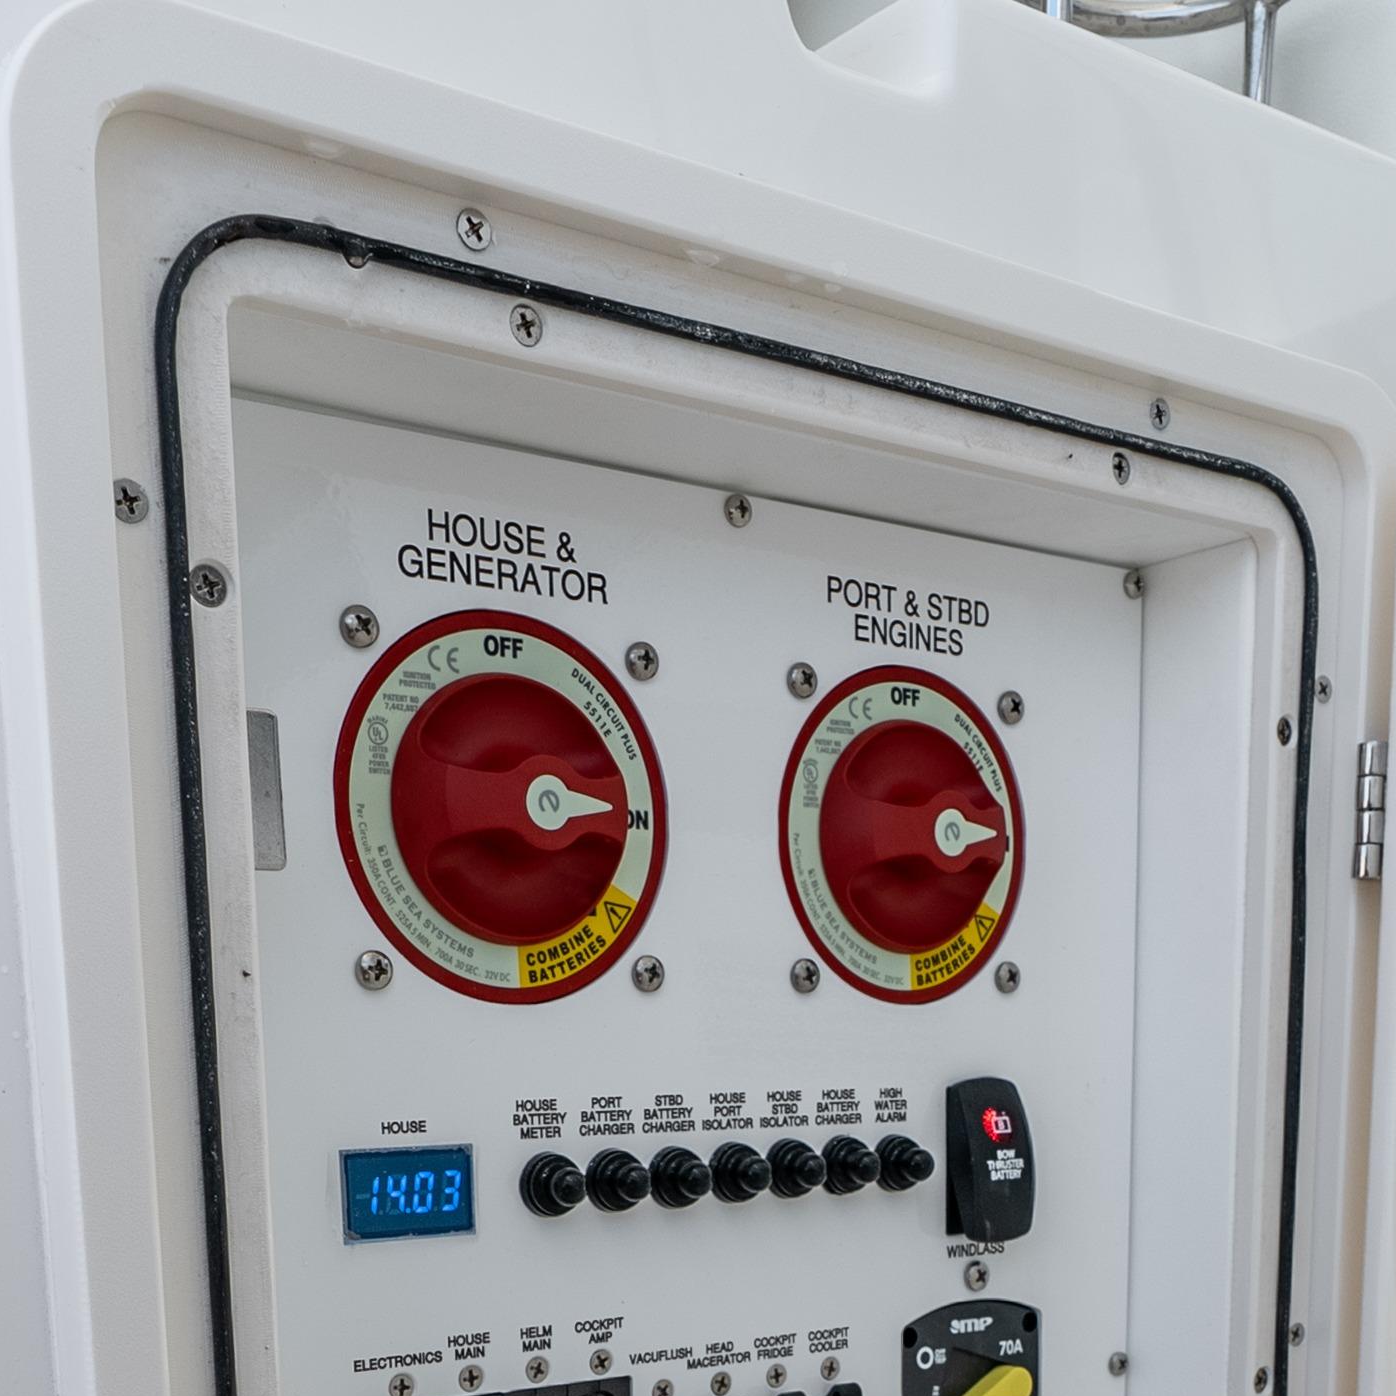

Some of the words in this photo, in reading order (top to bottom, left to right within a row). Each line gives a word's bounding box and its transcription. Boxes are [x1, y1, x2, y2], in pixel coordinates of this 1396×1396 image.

[428, 508, 546, 558] HOUSE
[557, 532, 577, 563] &
[398, 544, 608, 604] GENERATOR
[827, 575, 897, 612] PORT
[904, 590, 920, 617] &
[928, 593, 989, 627] STBD
[855, 613, 963, 656] ENGINES
[484, 635, 523, 659] OFF
[399, 679, 436, 690] PROTECTED
[383, 693, 407, 702] PATENT
[891, 686, 920, 706] OFF
[572, 668, 595, 695] DUAL
[596, 693, 624, 736] CIRCUIT
[621, 733, 637, 760] PLUS
[955, 714, 972, 736] DUAL
[972, 735, 993, 768] CIRCUIT
[991, 769, 1002, 792] PLUS
[383, 856, 406, 895] BLUE
[403, 895, 422, 920] SEA
[424, 919, 475, 958] SYSTEMS
[812, 879, 824, 909] BLUE
[825, 909, 840, 929] SEA
[840, 928, 878, 964] SYSTEMS
[526, 925, 593, 966] COMBINE
[915, 934, 967, 970] COMBINE
[528, 935, 607, 983] BATTERIES
[917, 947, 976, 986] BATTERIES
[655, 1095, 683, 1106] STBD
[710, 1092, 746, 1104] HOUSE
[767, 1091, 802, 1102] HOUSE
[822, 1089, 855, 1100] HOUSE
[880, 1088, 902, 1099] HIGH
[516, 1099, 557, 1112] HOUSE
[592, 1096, 622, 1108] PORT
[772, 1103, 798, 1115] STBD
[817, 1101, 860, 1113] BATTERY
[875, 1100, 907, 1111] WATER
[581, 1110, 632, 1123] BATTERY
[644, 1107, 693, 1120] BATTERY
[714, 1106, 741, 1117] PORT
[875, 1112, 907, 1123] ALARM
[513, 1112, 566, 1126] BATTERY
[702, 1117, 753, 1131] ISOLATOR
[760, 1115, 808, 1128] ISOLATOR
[815, 1113, 861, 1126] CHARGER
[381, 1121, 426, 1134] HOUSE
[520, 1126, 561, 1139] METER
[579, 1123, 635, 1136] CHARGER
[642, 1120, 695, 1133] CHARGER
[996, 1149, 1016, 1160] BOW
[987, 1159, 1024, 1170] THRUSTER
[991, 1169, 1022, 1181] BATTERY
[371, 1169, 461, 1215] 14.03
[947, 1242, 1004, 1258] WINDLASS
[575, 1317, 624, 1332] COCKPIT
[520, 1325, 552, 1339] HELM
[589, 1332, 612, 1344] AMP
[808, 1327, 849, 1341] COCKPIT
[448, 1332, 490, 1348] HOUSE
[523, 1339, 551, 1352] MAIN
[754, 1333, 797, 1348] COCKPIT
[809, 1339, 848, 1353] COOLER
[455, 1346, 485, 1360] MAIN
[706, 1341, 733, 1354] HEAD
[757, 1346, 794, 1360] FRIDGE
[999, 1339, 1023, 1356] 70A
[354, 1351, 442, 1372] ELECTRONICS
[630, 1347, 693, 1365] VACUFLUSH
[687, 1351, 751, 1370] MACERATOR
